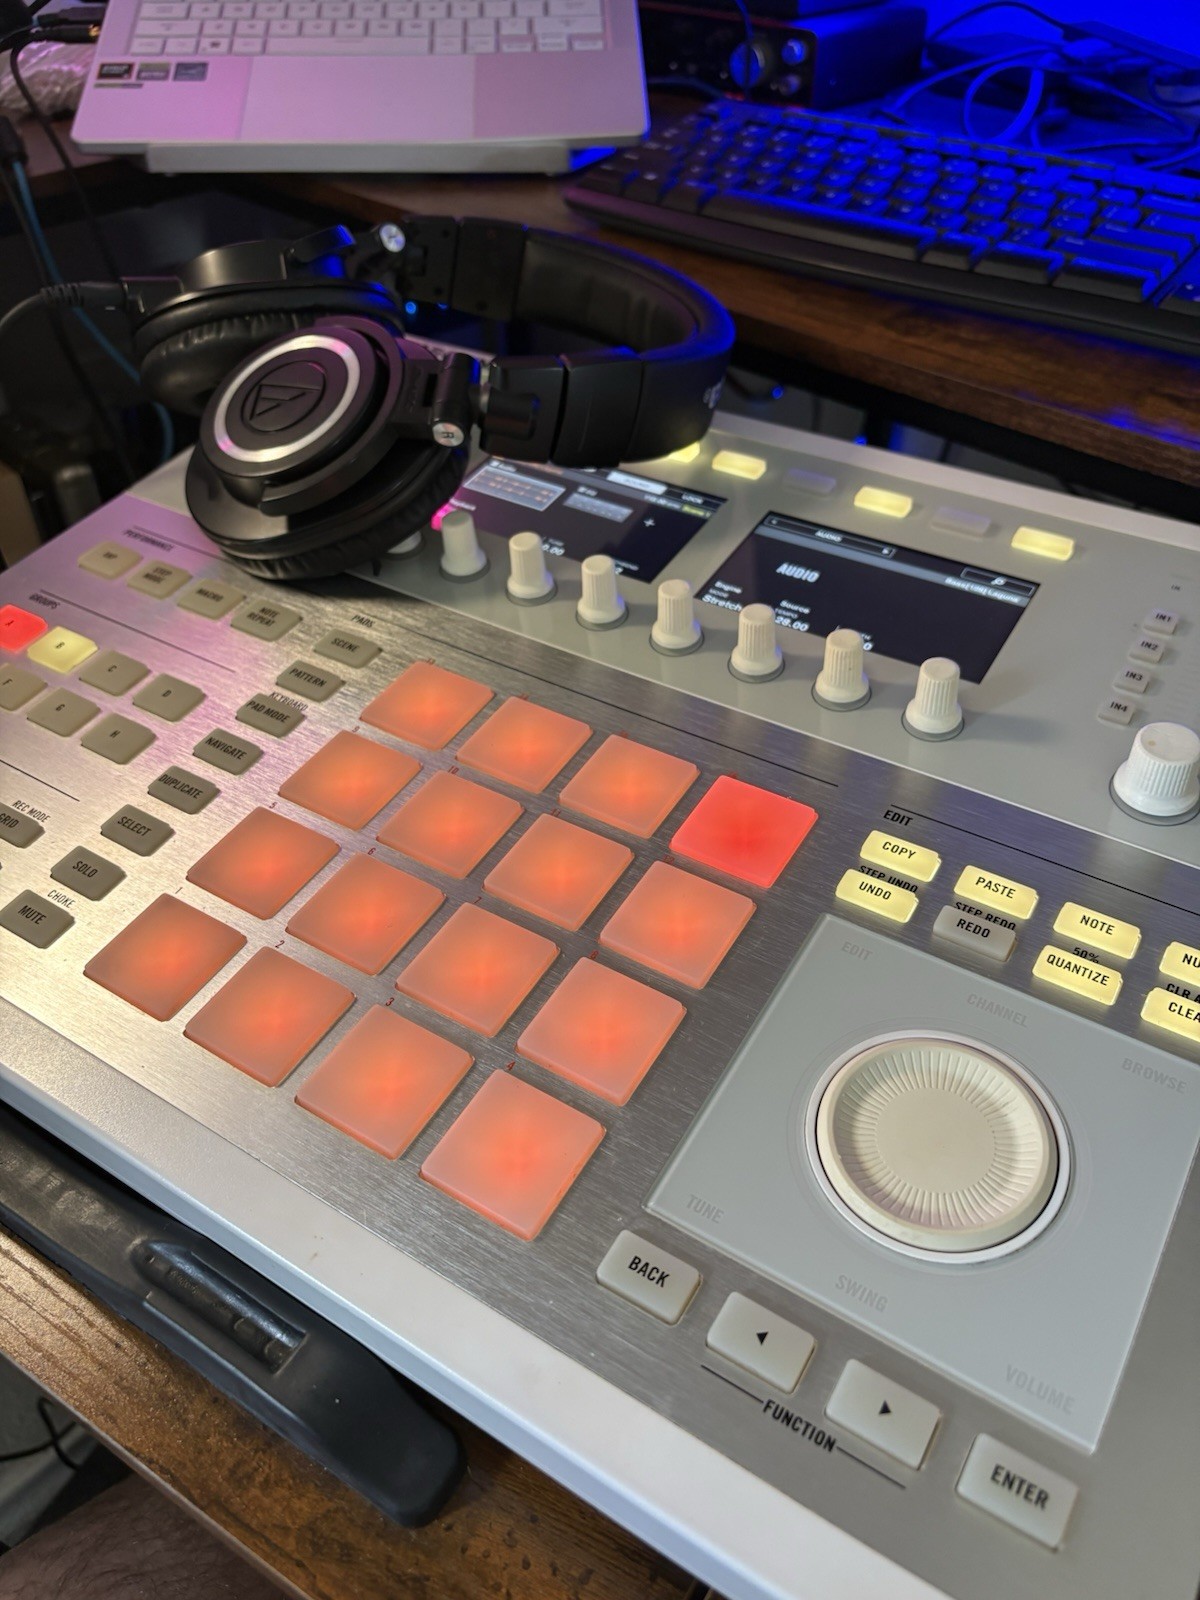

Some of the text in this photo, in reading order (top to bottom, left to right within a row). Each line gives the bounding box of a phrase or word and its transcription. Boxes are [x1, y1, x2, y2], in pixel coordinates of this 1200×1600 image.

[776, 562, 820, 583] AUDIO
[196, 588, 224, 602] MACRO
[714, 581, 742, 594] Engine
[29, 592, 60, 610] GROUPS
[702, 593, 742, 612] Stretch
[780, 600, 811, 614] Source
[247, 613, 275, 627] REPEAT
[259, 607, 280, 618] NOTE
[351, 614, 375, 628] PADS
[1155, 612, 1171, 623] IN1
[331, 637, 360, 652] SCENE
[1140, 640, 1158, 651] IN2
[289, 668, 328, 688] PATTERN
[1125, 670, 1143, 682] IN3
[246, 700, 290, 723] PAD MODE
[270, 692, 309, 712] KEYBOARD
[1109, 701, 1128, 713] IN4
[352, 725, 361, 734] 9
[205, 736, 248, 761] NAVIGATE
[448, 765, 459, 775] 10
[158, 773, 204, 800] DUPLICATE
[12, 800, 51, 823] REC MODE
[269, 802, 277, 810] 5
[117, 815, 153, 838] SELECT
[883, 809, 914, 827] EDIT
[367, 847, 376, 856] 6
[881, 841, 917, 860] COPY
[72, 860, 98, 878] SOLO
[858, 865, 919, 894] STEP UNDO
[975, 876, 1017, 899] PASTE
[47, 889, 76, 909] CHOKE
[474, 896, 483, 904] 7
[858, 881, 892, 900] UNDO
[18, 905, 47, 925] MUTE
[956, 918, 991, 938] REDO
[1079, 914, 1116, 936] NOTE
[275, 940, 285, 949] 2
[841, 941, 874, 961] EDIT
[1072, 947, 1100, 964] 50%
[1046, 954, 1110, 986] QUANTIZE
[385, 997, 395, 1006] 3
[967, 993, 1030, 1028] CHANNEL
[506, 1061, 516, 1071] 4
[1120, 1057, 1188, 1094] BROWSE
[686, 1194, 725, 1224] TUNE
[628, 1255, 670, 1288] BACK
[835, 1274, 889, 1314] SWING
[1004, 1364, 1075, 1415] VOLUME
[761, 1400, 837, 1453] FUNCTION
[990, 1464, 1050, 1511] ENTER
